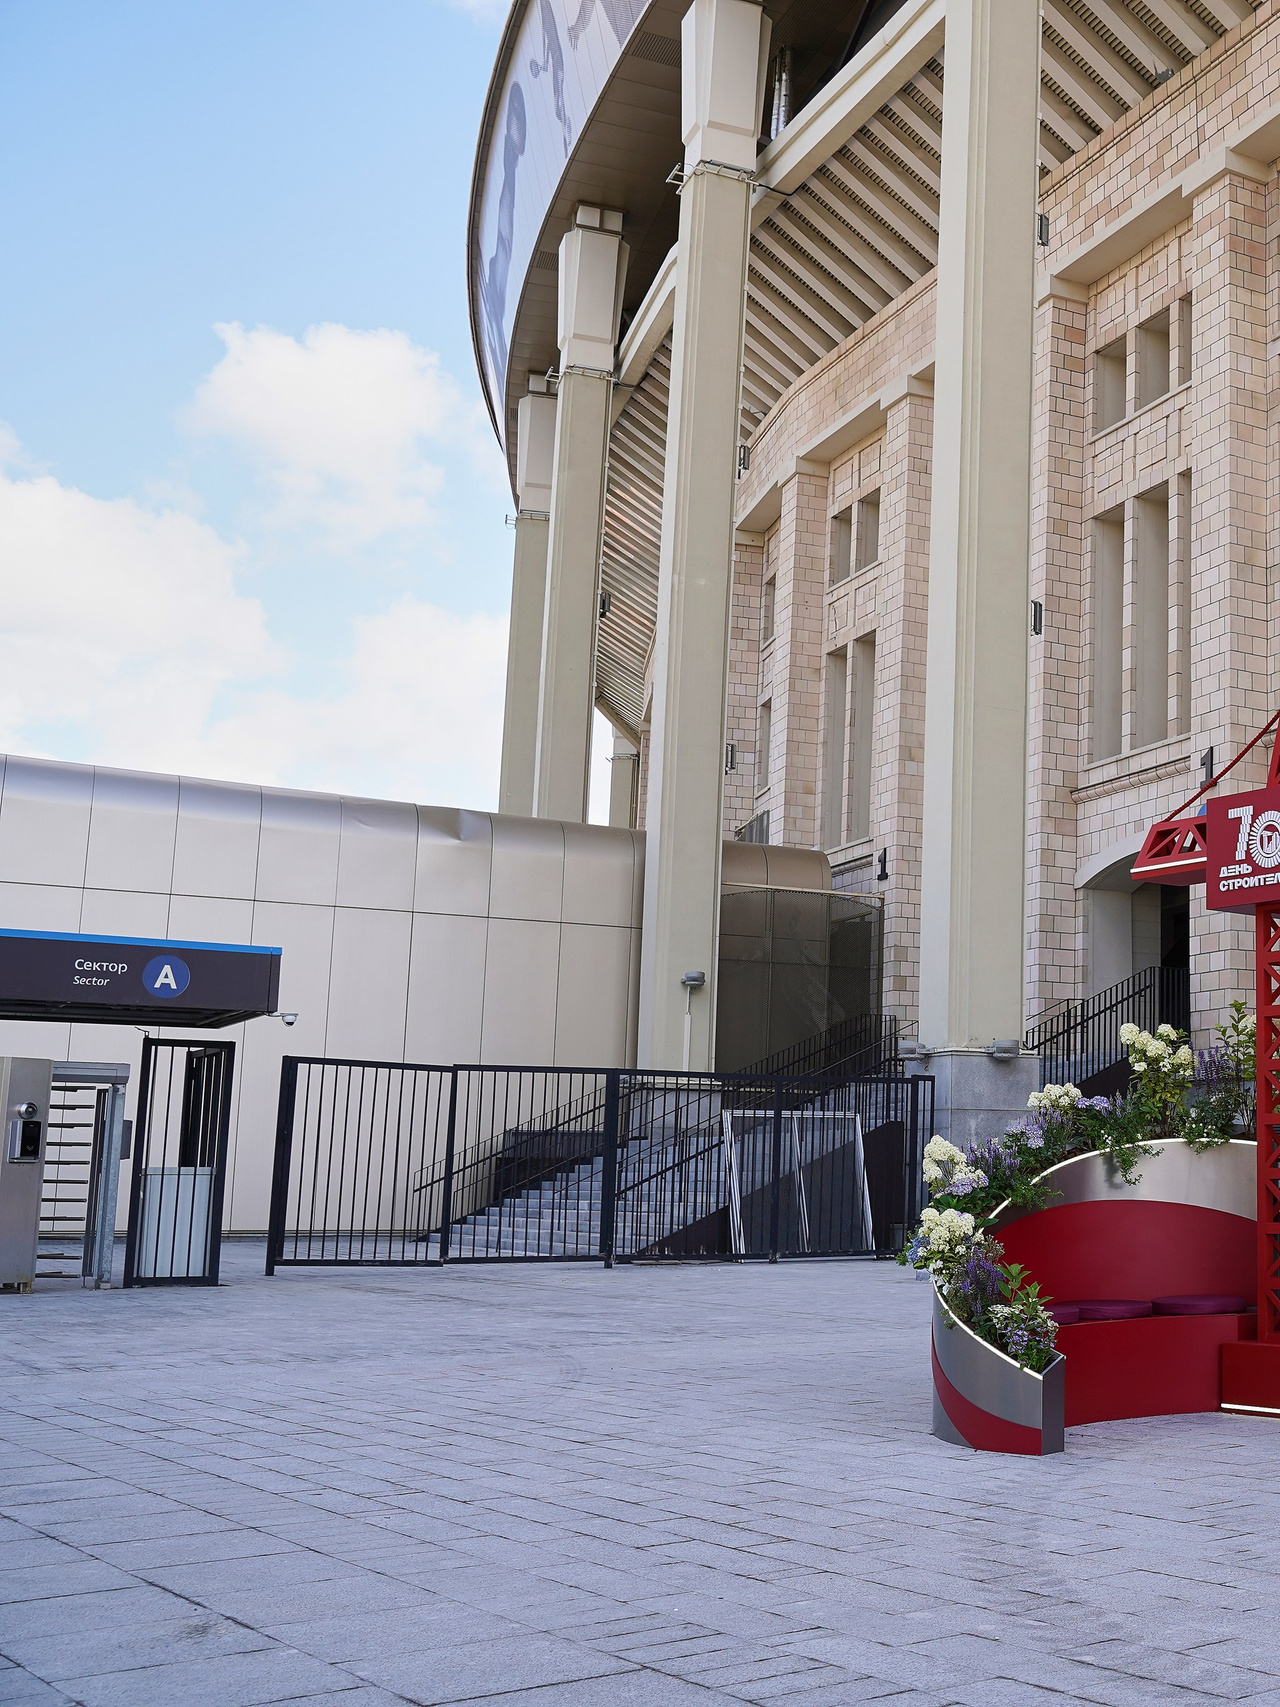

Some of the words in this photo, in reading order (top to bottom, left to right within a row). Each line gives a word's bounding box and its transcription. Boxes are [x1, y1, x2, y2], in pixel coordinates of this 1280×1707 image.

[1200, 746, 1217, 788] 1
[877, 847, 888, 881] 1
[1219, 863, 1252, 877] ДЕНЬ
[74, 958, 128, 975] Сектор
[73, 975, 110, 986] Sector
